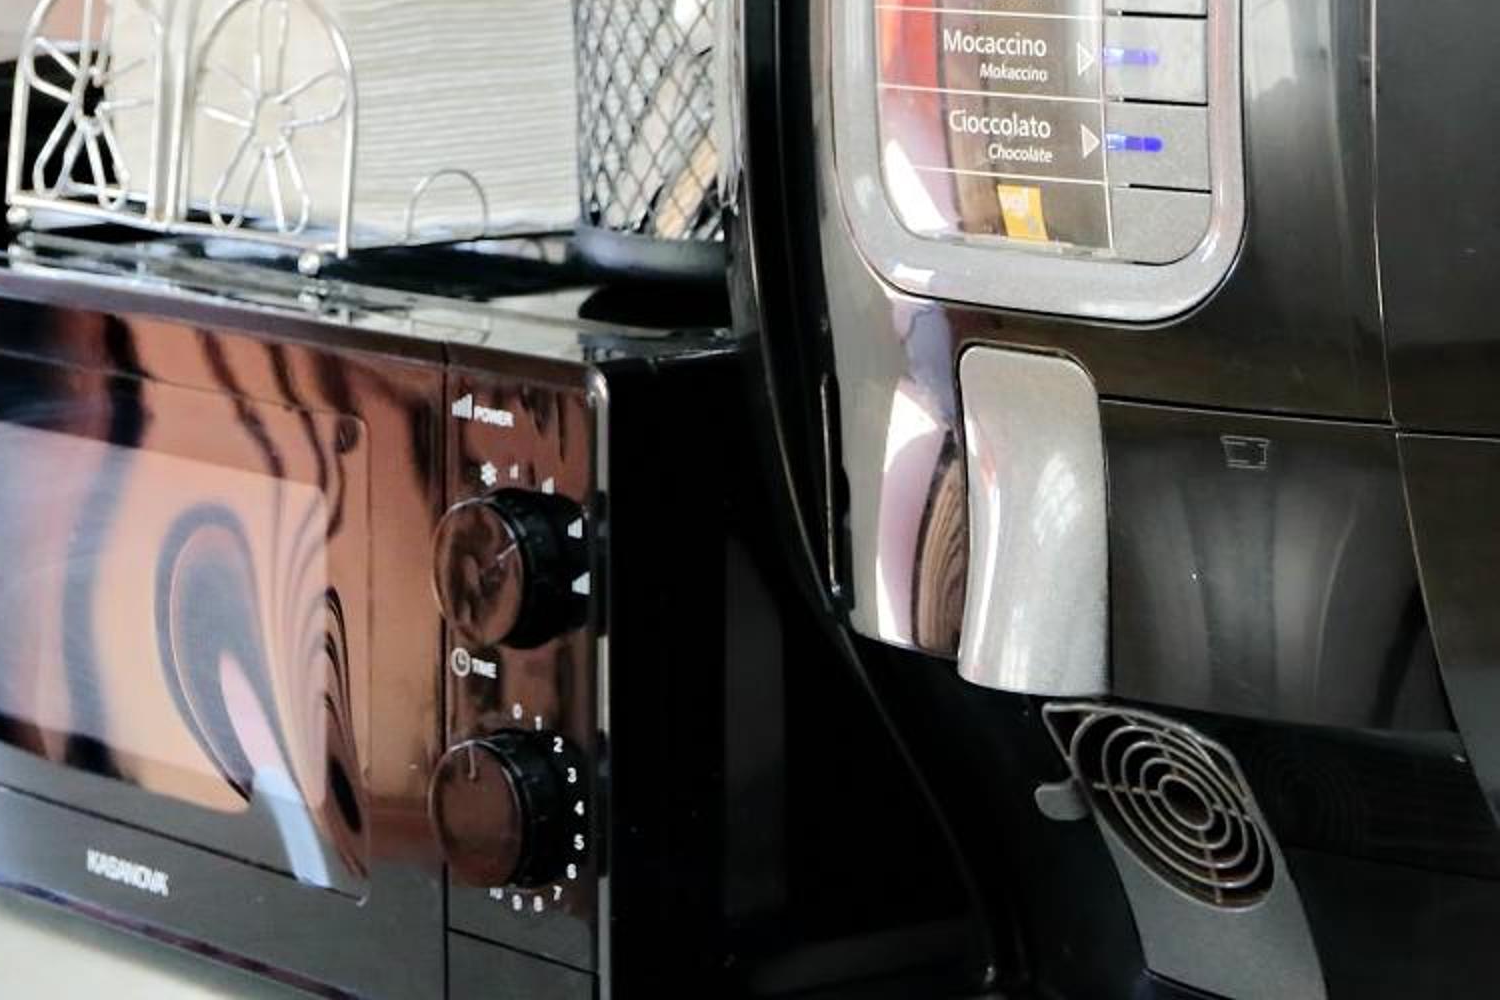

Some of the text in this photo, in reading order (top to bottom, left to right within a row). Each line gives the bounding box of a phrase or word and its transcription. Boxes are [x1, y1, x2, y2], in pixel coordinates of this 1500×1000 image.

[942, 29, 1047, 57] Mocaccino
[979, 63, 1048, 83] Mokaccino
[948, 109, 1052, 139] Cioccolato
[988, 144, 1053, 164] Chocolate
[474, 404, 515, 428] POWER
[471, 657, 497, 679] TIME
[553, 736, 564, 753] 2
[567, 767, 577, 784] 3
[574, 800, 585, 816] 4
[574, 833, 585, 851] 5
[566, 863, 577, 880] 6
[553, 885, 563, 901] 7
